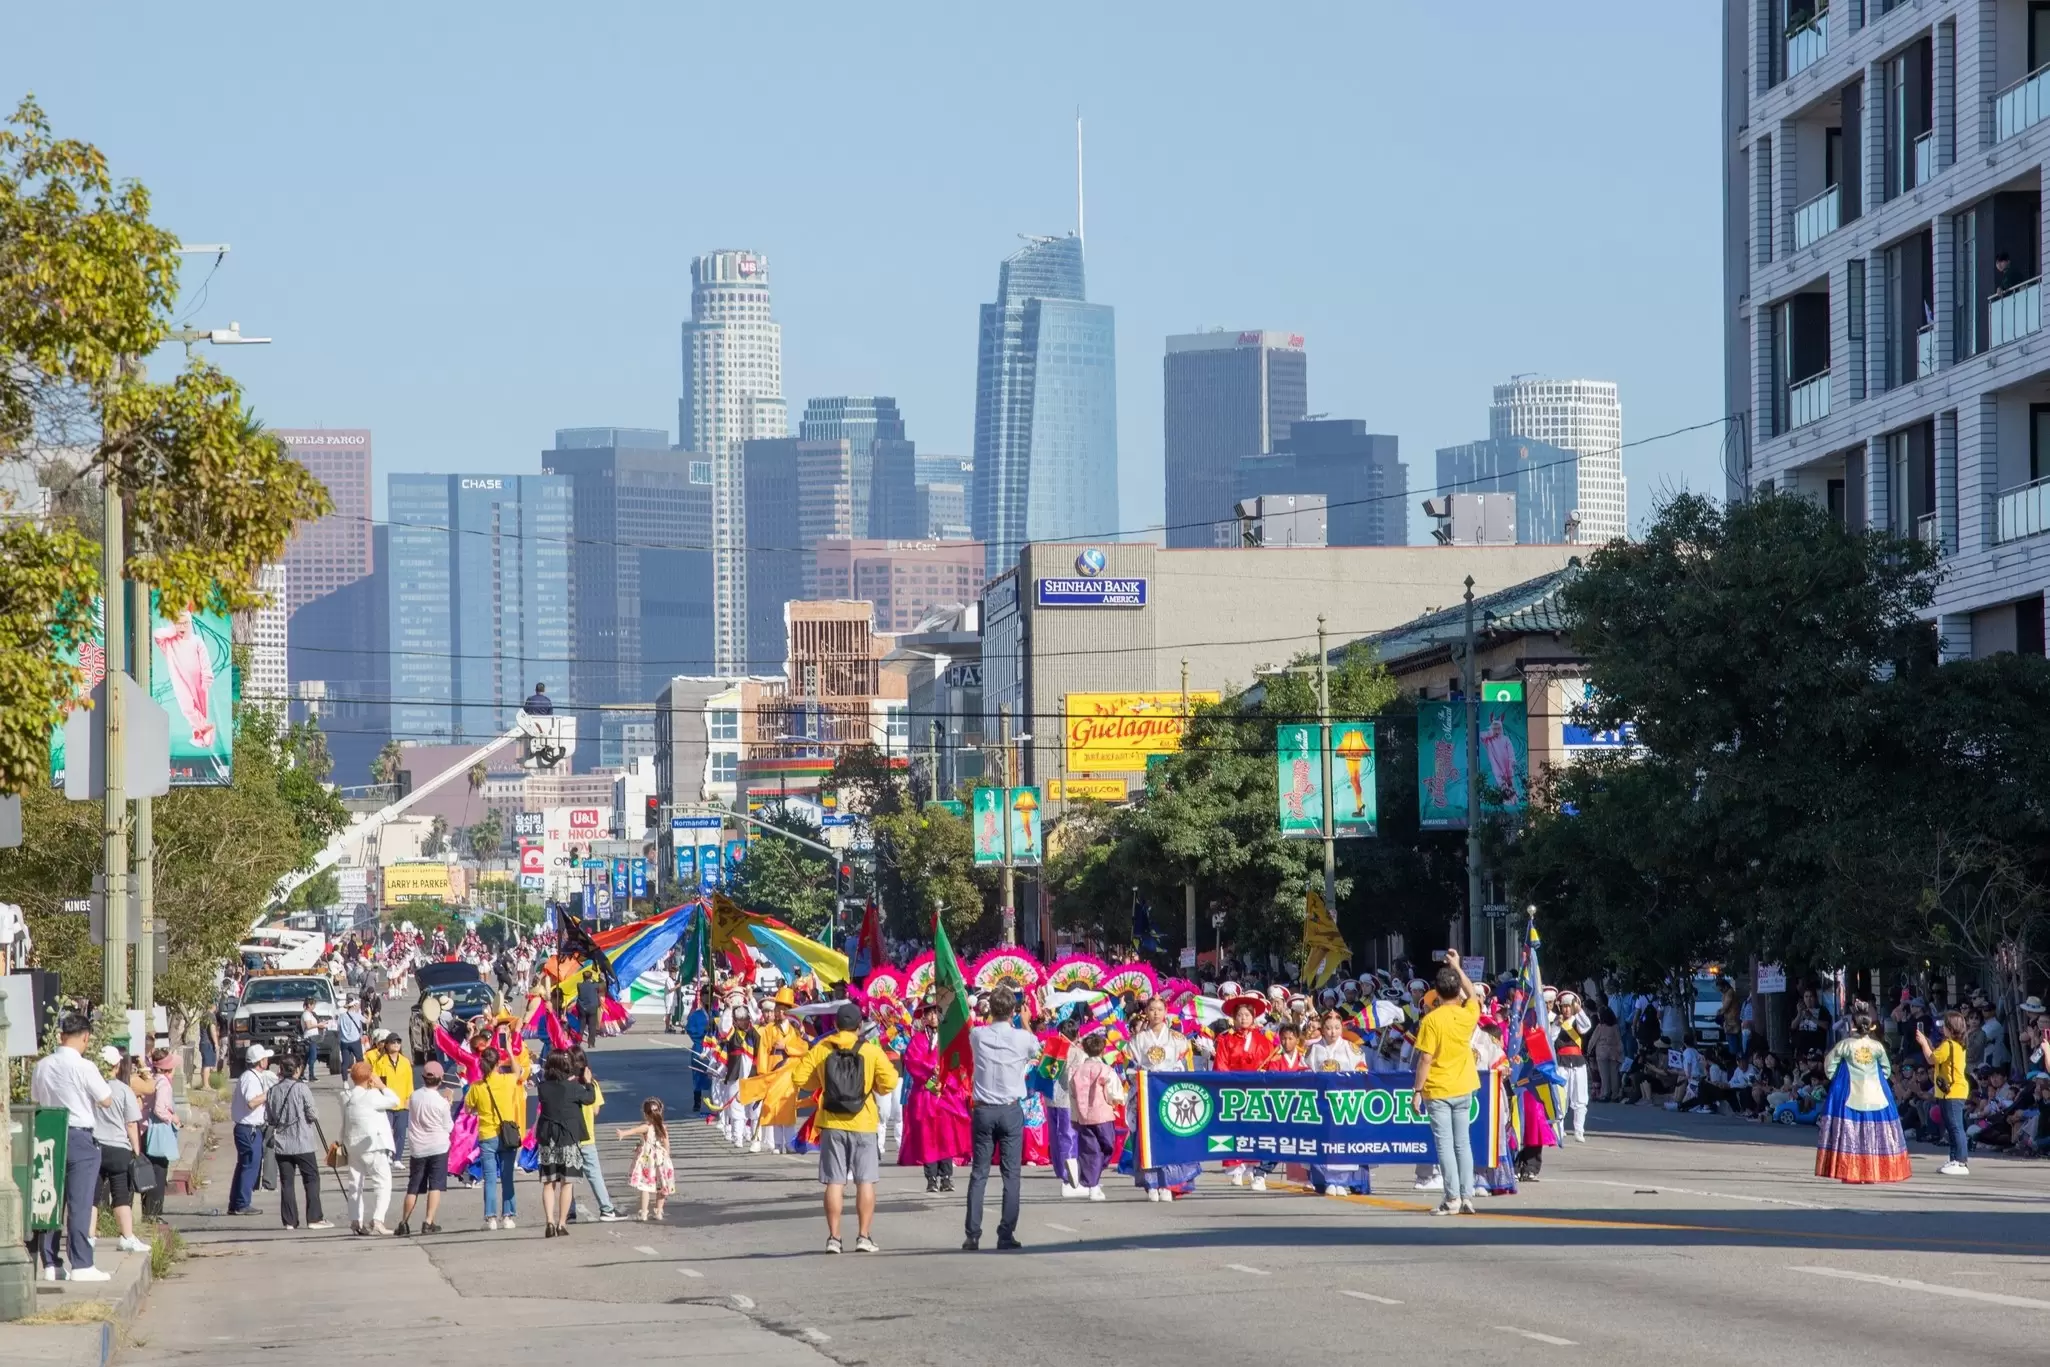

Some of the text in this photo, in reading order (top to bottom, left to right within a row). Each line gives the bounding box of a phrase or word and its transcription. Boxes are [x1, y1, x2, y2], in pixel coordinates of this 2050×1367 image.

[284, 435, 365, 445] WELLS FARGO
[461, 479, 502, 489] CHASE
[915, 542, 937, 551] Care
[1045, 580, 1140, 592] SHINHAN BANK
[1102, 595, 1139, 604] AMERICA
[944, 666, 982, 688] CHAS
[1442, 705, 1453, 740] Musical
[573, 811, 597, 824] U&L
[536, 824, 544, 834] 있
[548, 829, 612, 840] TEHNOLO
[387, 879, 448, 889] LARRY H. PARKER
[65, 900, 90, 912] KINGS
[1162, 1083, 1210, 1102] PAVA WORLD
[1219, 1089, 1322, 1124] PAVA
[1326, 1088, 1480, 1126] WOR
[1236, 1136, 1318, 1156] 한국일보
[1321, 1141, 1428, 1154] THE KOREA TIMES
